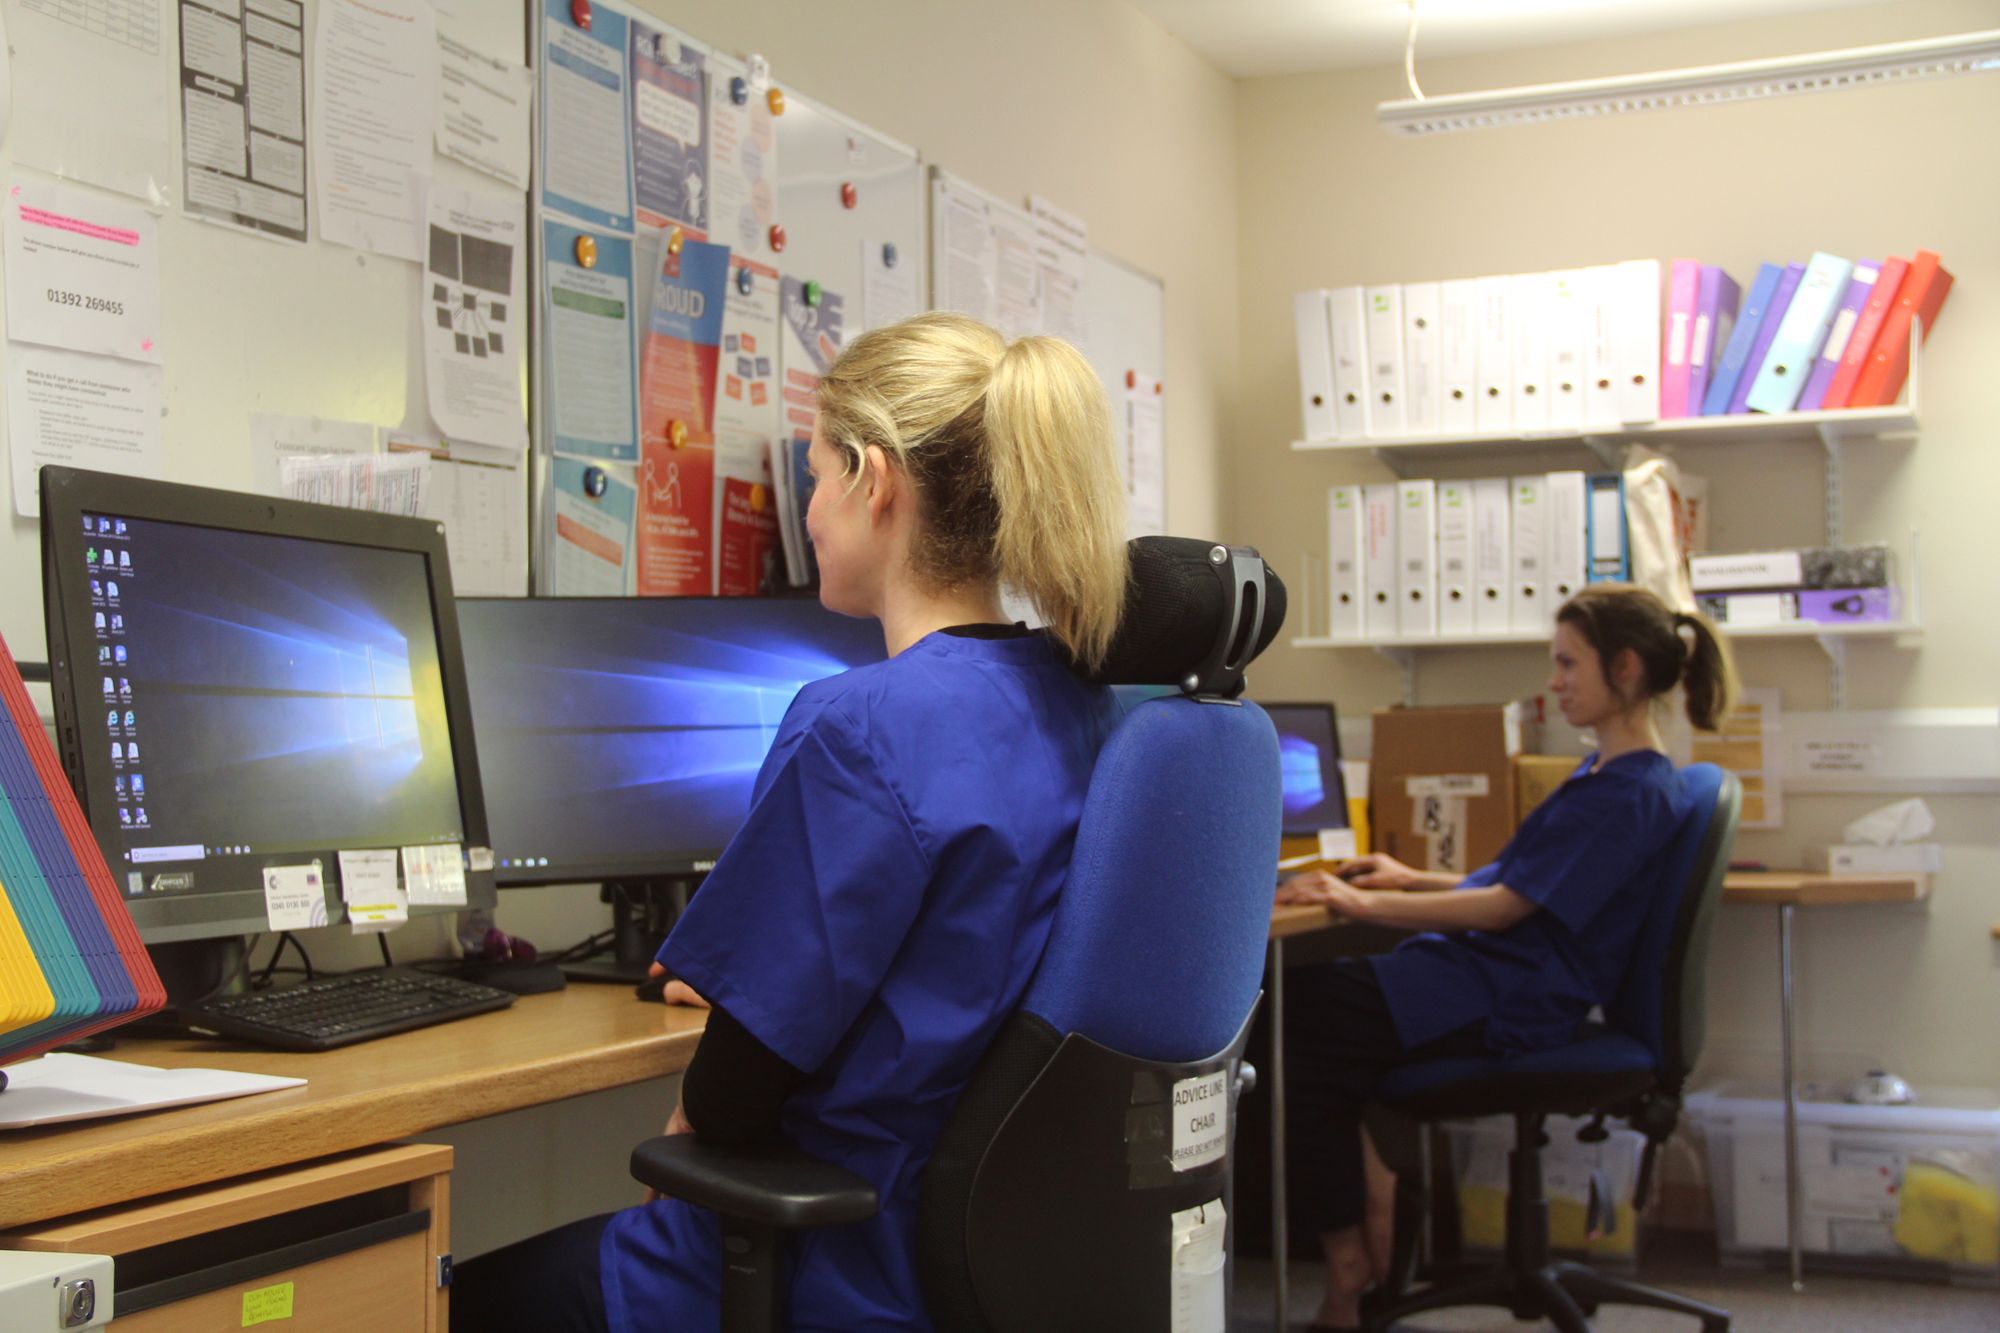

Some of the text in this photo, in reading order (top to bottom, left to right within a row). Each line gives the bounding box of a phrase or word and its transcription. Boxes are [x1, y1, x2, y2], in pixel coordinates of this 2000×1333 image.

[47, 288, 124, 316] 01392 269455
[1173, 1079, 1223, 1106] ADVICE LINE
[1190, 1112, 1216, 1133] CHAIR
